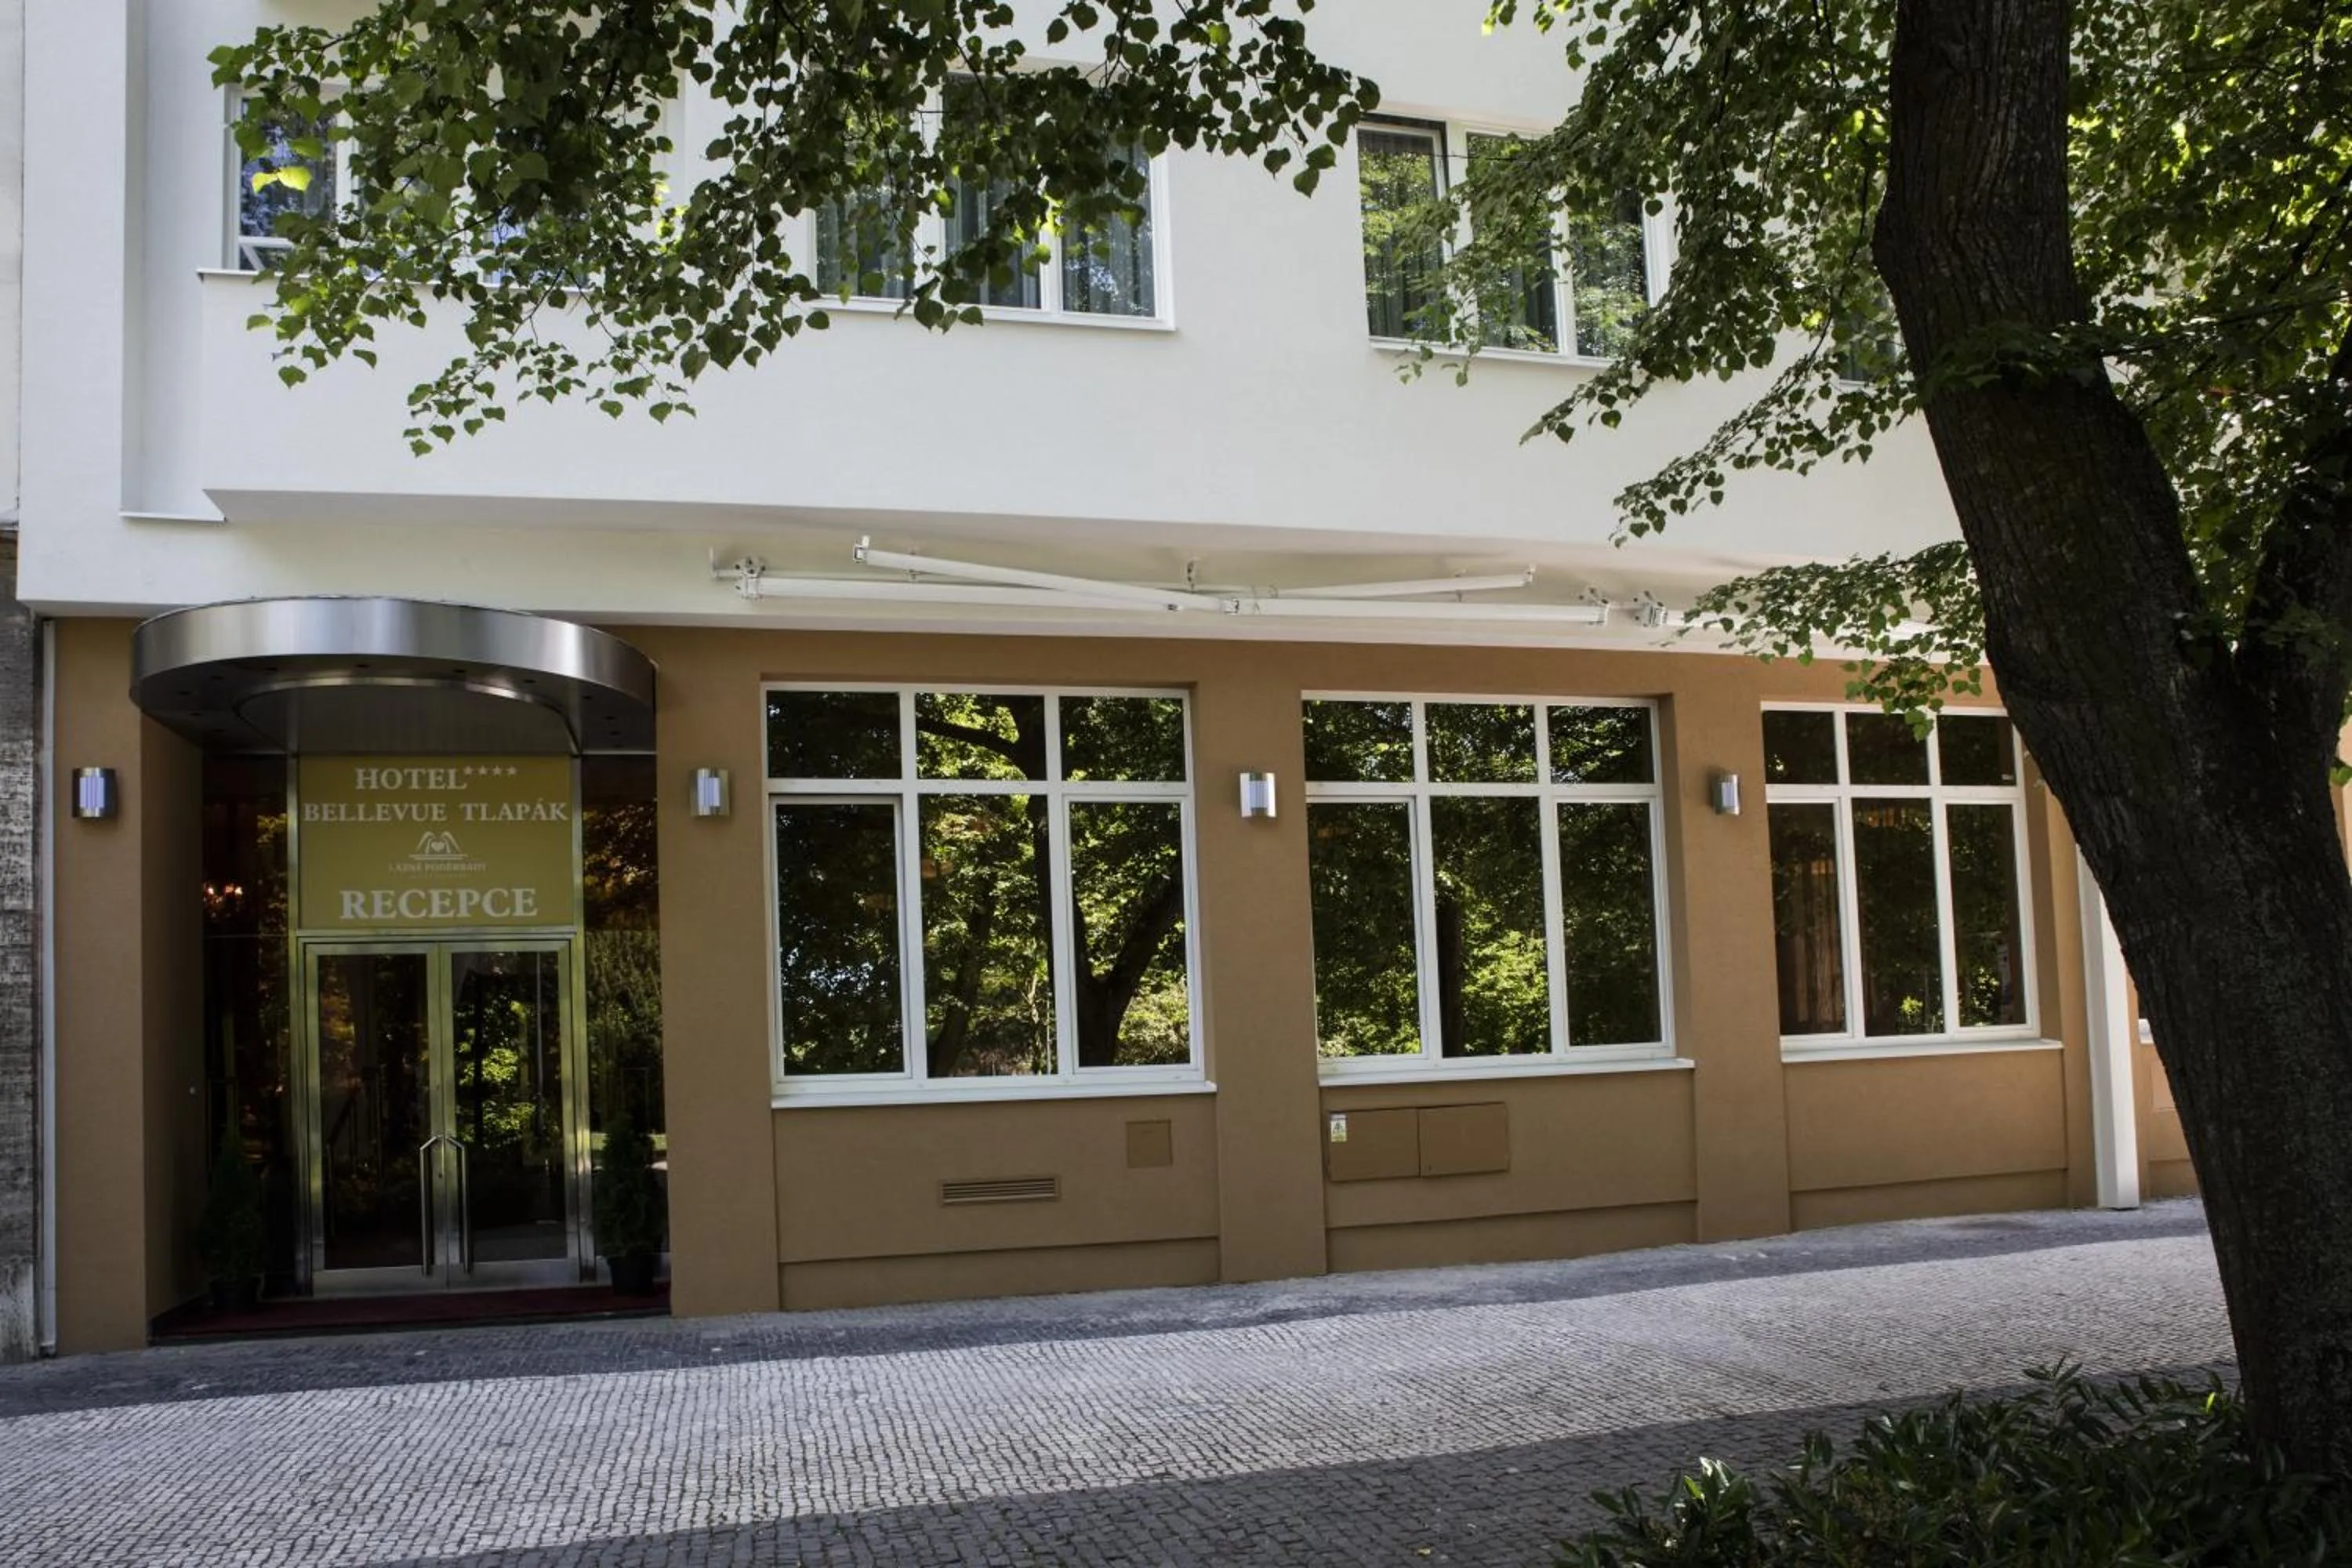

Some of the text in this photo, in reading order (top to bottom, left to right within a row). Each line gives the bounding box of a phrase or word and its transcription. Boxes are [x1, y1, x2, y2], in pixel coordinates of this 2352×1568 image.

[355, 768, 467, 789] HOTEL
[303, 802, 448, 822] BELLEVUE
[339, 888, 539, 920] RECEPCE
